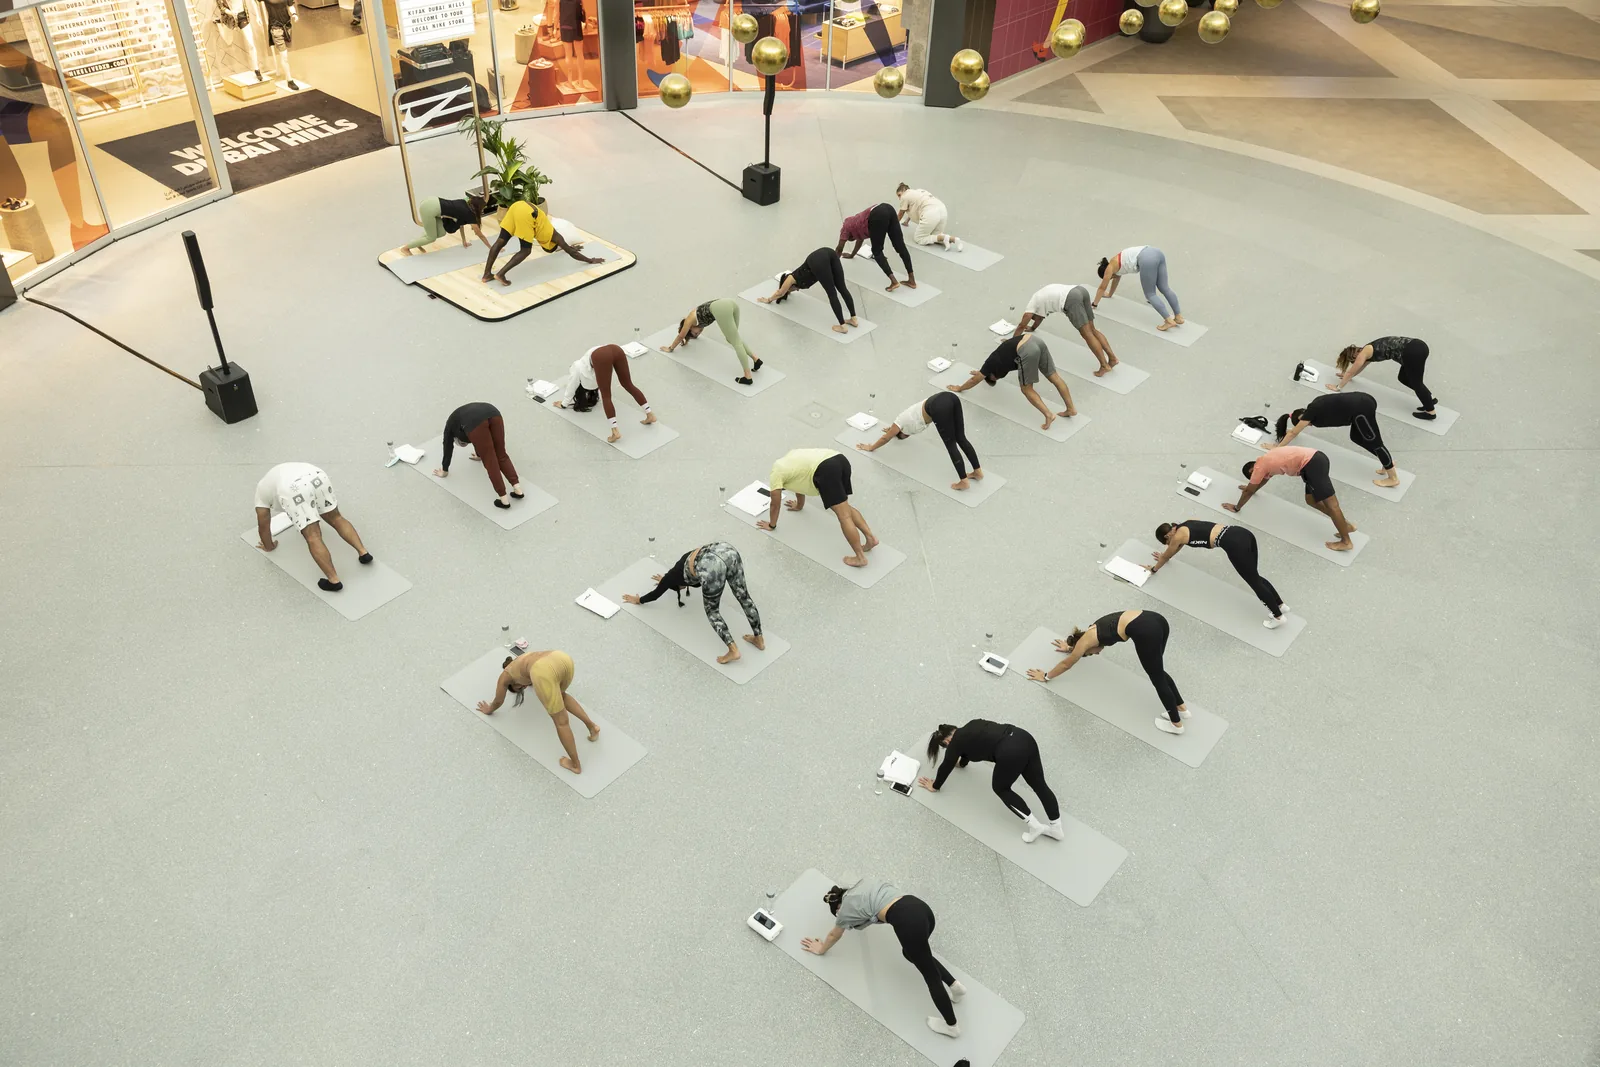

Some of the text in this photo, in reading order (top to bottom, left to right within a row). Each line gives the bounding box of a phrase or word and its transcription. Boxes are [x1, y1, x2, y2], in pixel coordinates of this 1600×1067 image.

[408, 1, 465, 16] KIFAK DUBAI HILLS
[57, 17, 106, 31] INTERNATIONAL
[412, 15, 438, 24] WELCOME
[412, 25, 429, 33] LOCAL
[448, 18, 465, 26] STORE
[82, 38, 98, 46] WITH
[94, 43, 119, 52] KRISHNA
[281, 118, 358, 147] HILLS
